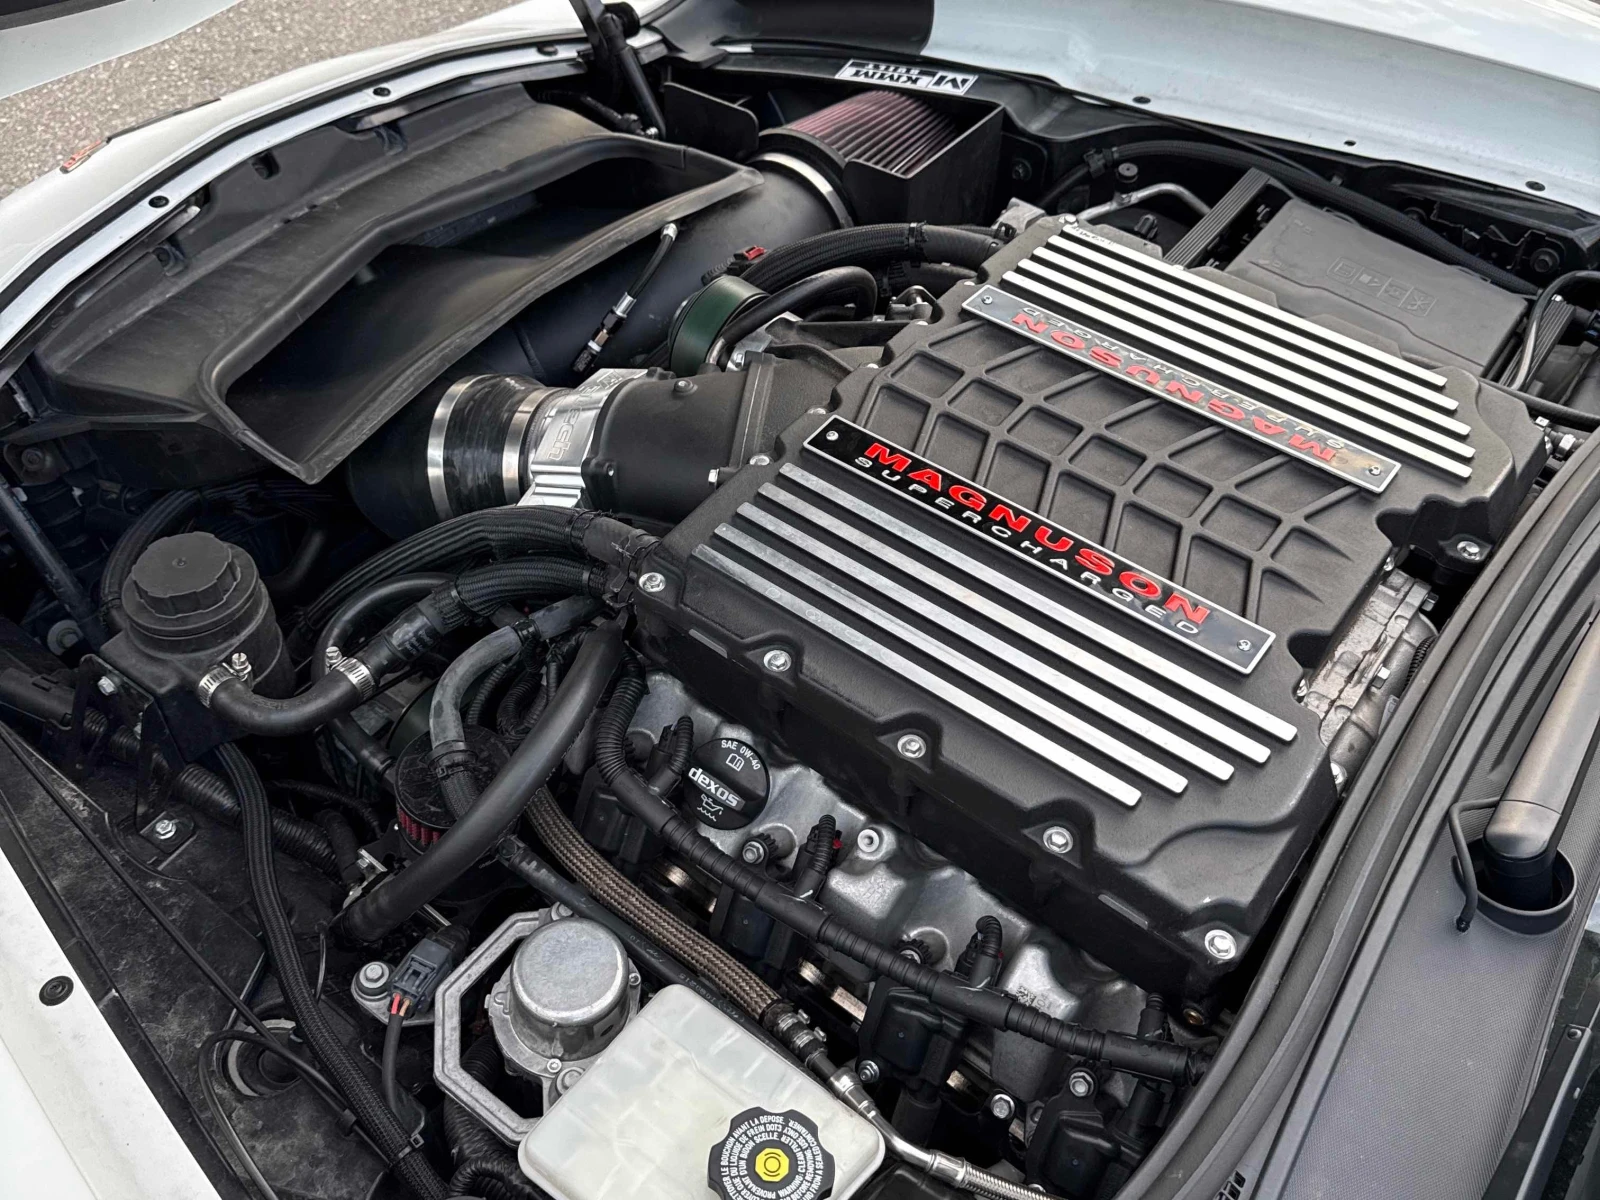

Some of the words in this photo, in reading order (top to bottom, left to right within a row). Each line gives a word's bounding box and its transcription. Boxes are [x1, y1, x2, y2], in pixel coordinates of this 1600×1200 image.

[850, 69, 924, 84] KMM
[864, 64, 920, 74] BUILT
[1012, 312, 1340, 463] MAGNUSON
[1021, 306, 1346, 450] SUPERCHARGED
[863, 441, 1212, 625] MAGNUSON
[854, 456, 1200, 635] SUPERCHARGED
[721, 740, 738, 750] SAE
[740, 746, 760, 770] 0W-40
[688, 768, 740, 806] dexos
[749, 1118, 760, 1127] LA
[759, 1115, 785, 1124] DEPOSE.
[766, 1123, 782, 1132] DOT3
[732, 1121, 750, 1139] AVANT
[739, 1134, 749, 1144] DE
[746, 1125, 765, 1137] FREIN
[753, 1132, 779, 1143] SCELLE.
[783, 1127, 799, 1139] ONLY
[788, 1119, 817, 1147] CONTAINER.
[720, 1136, 736, 1166] BOUCHON
[739, 1140, 756, 1159] BIDON
[781, 1134, 801, 1153] FILLER
[796, 1136, 809, 1149] USE
[729, 1141, 743, 1166] LIQUIDE
[796, 1151, 806, 1173] CLEAN
[812, 1146, 824, 1169] SEALED
[721, 1167, 729, 1175] LE
[730, 1167, 738, 1176] DU
[738, 1160, 748, 1175] D'UN
[804, 1147, 815, 1182] REMOVING.
[732, 1176, 744, 1191] QUE
[741, 1176, 776, 1199] PROVENANT
[777, 1174, 804, 1198] WARNING:
[790, 1180, 811, 1200] BEFORE
[809, 1175, 822, 1193] FROM
